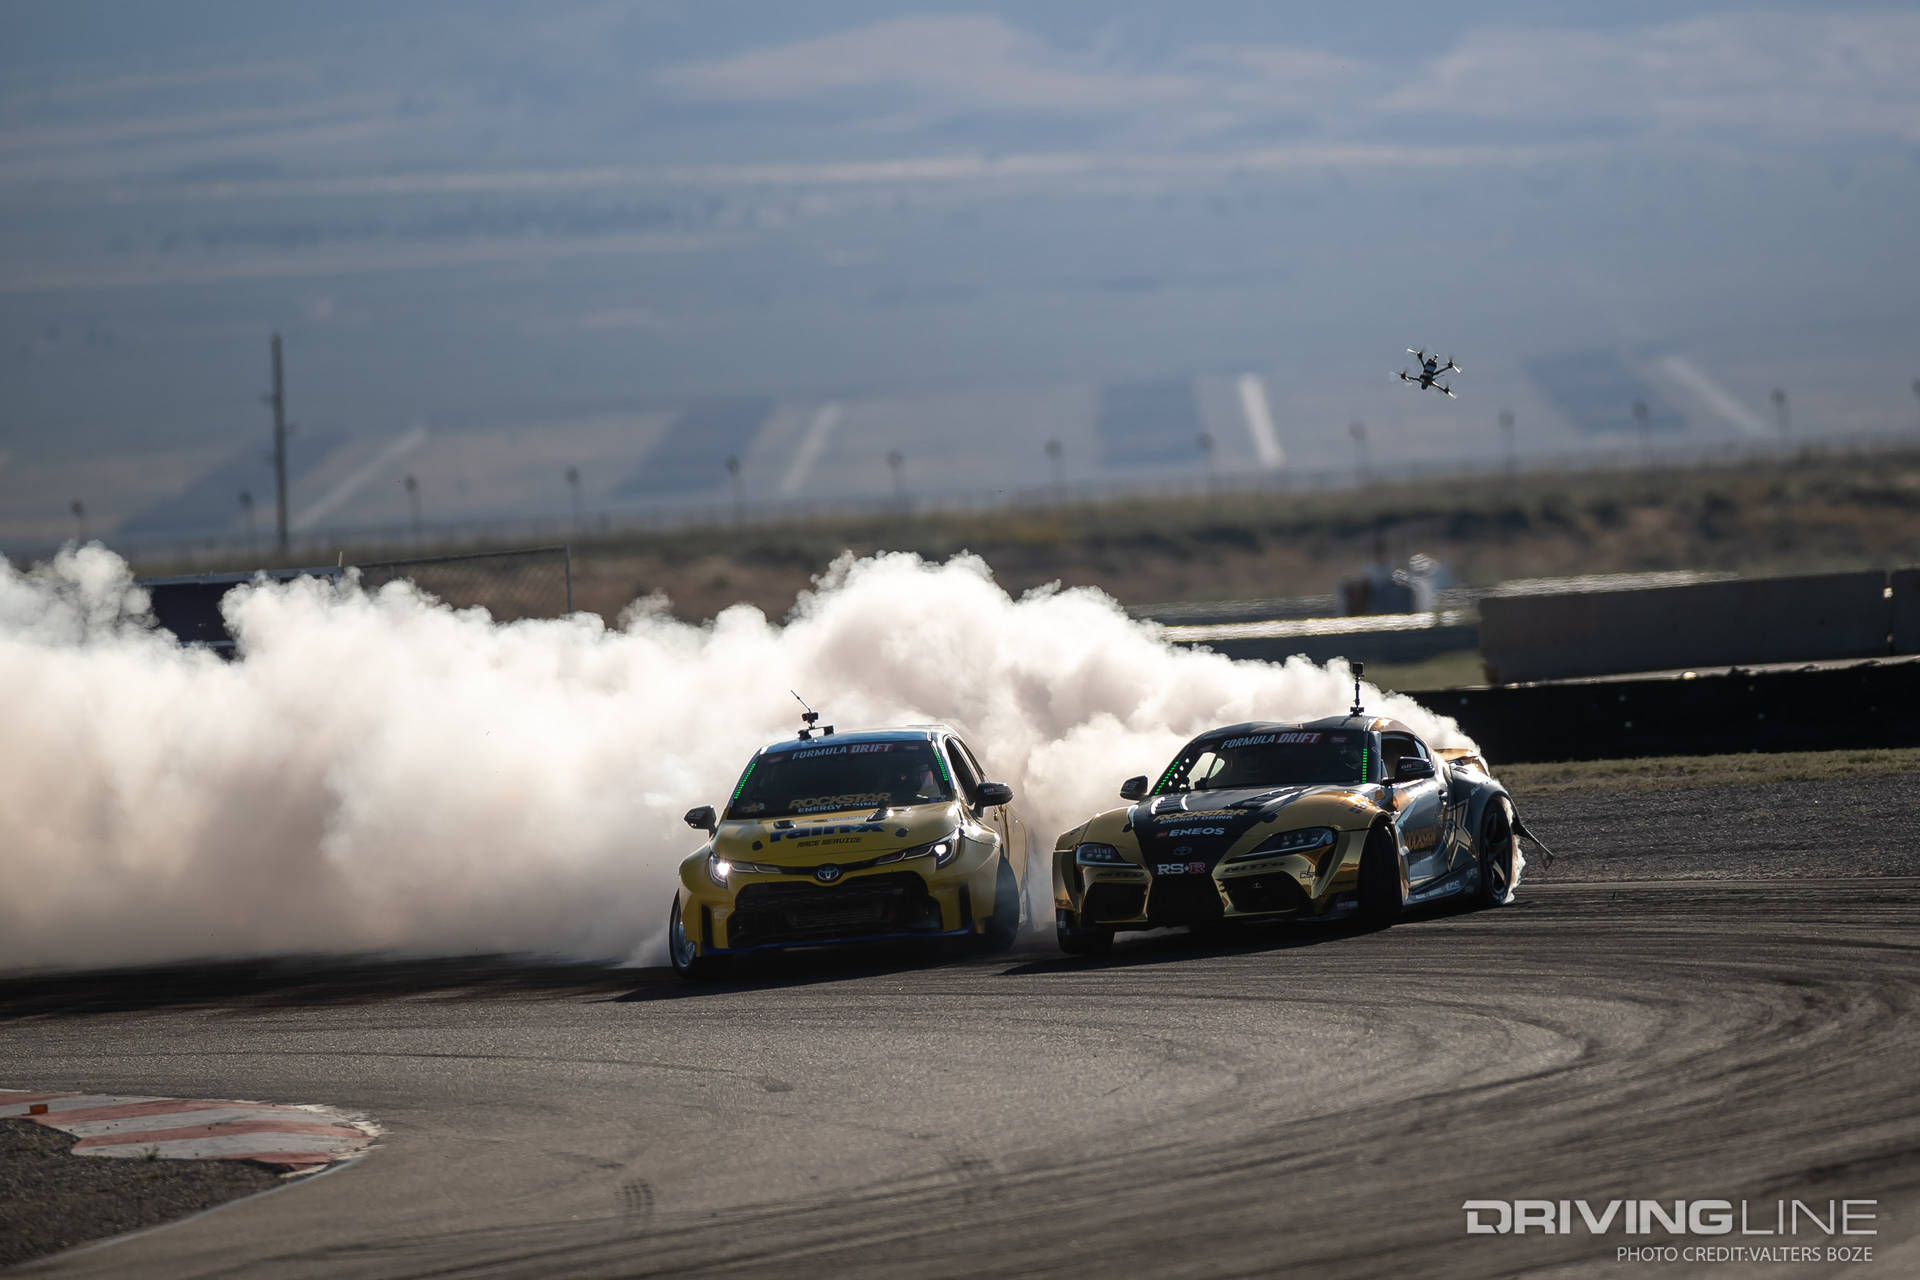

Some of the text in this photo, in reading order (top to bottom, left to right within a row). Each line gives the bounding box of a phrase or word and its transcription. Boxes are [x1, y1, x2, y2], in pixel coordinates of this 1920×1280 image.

[1221, 734, 1276, 750] FORMULA
[1277, 732, 1321, 744] DRIFT
[792, 746, 847, 760] FORMULA
[850, 743, 892, 754] DRIFT
[788, 793, 891, 809] ROCKSTAR
[798, 804, 841, 814] ENERGY
[1152, 808, 1249, 823] ROCKSTAR
[1160, 816, 1200, 825] ENERGY
[1168, 827, 1225, 838] ENEOS
